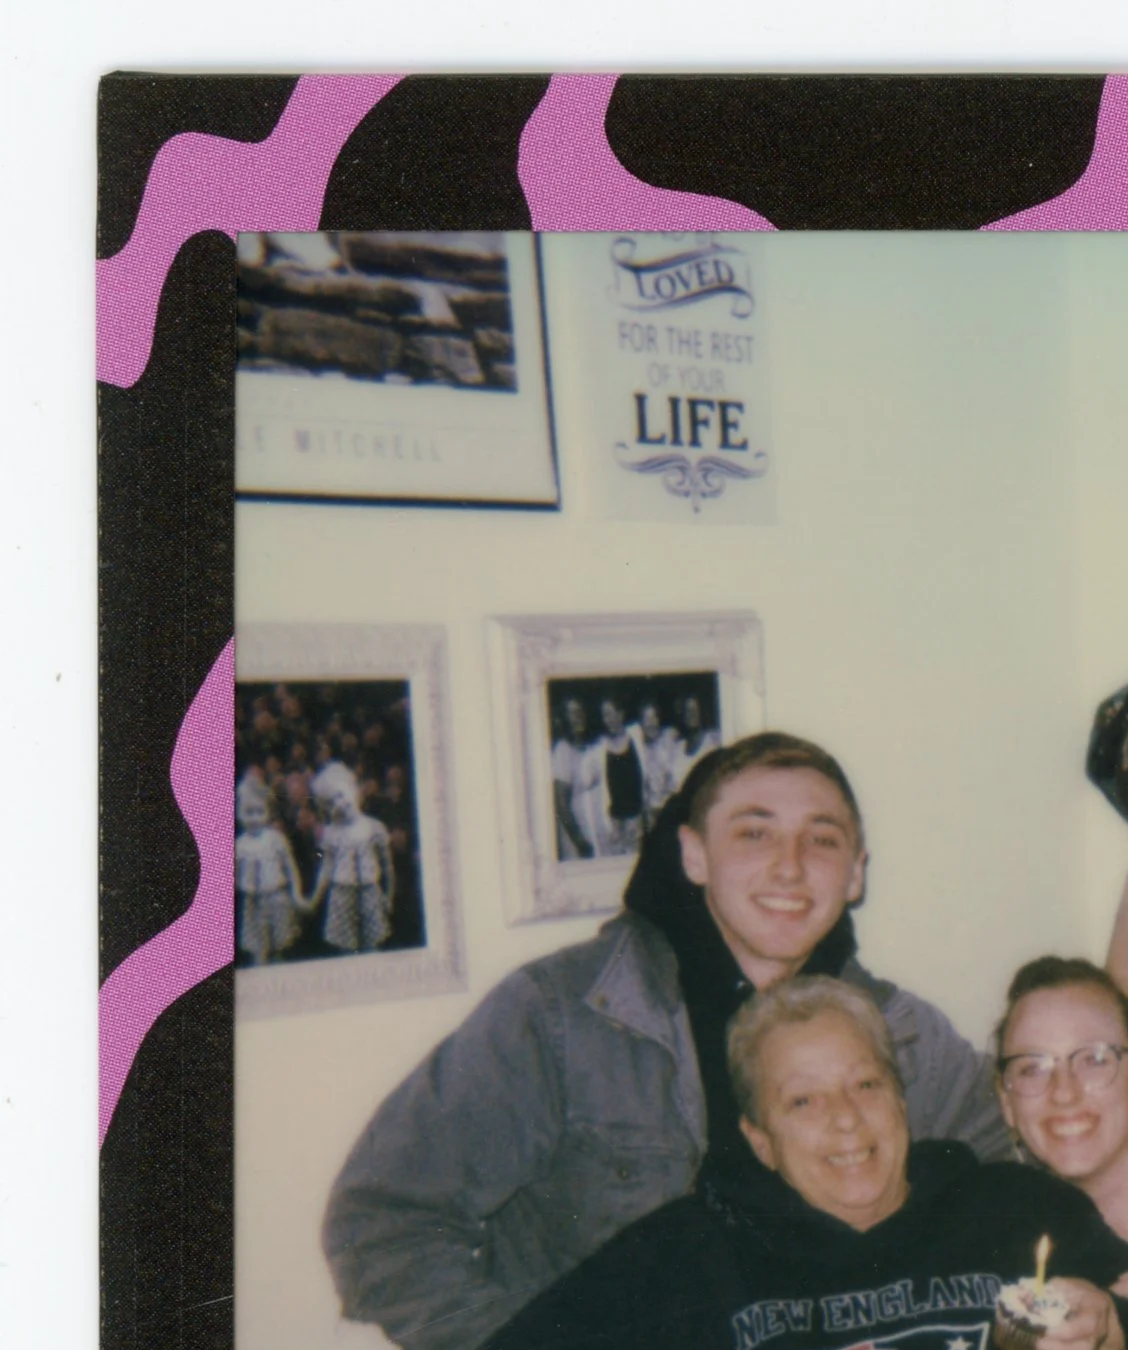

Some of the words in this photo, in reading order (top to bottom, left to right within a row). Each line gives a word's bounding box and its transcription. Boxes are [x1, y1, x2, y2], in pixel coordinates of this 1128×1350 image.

[633, 258, 736, 301] LOVED
[617, 320, 659, 354] FOR
[665, 325, 704, 359] THE
[710, 331, 756, 365] REST
[646, 361, 671, 388] OF
[677, 365, 726, 393] YOUR
[634, 392, 750, 452] LIFE
[293, 428, 443, 461] MITCHELL
[820, 1274, 1002, 1332] ENGLAND
